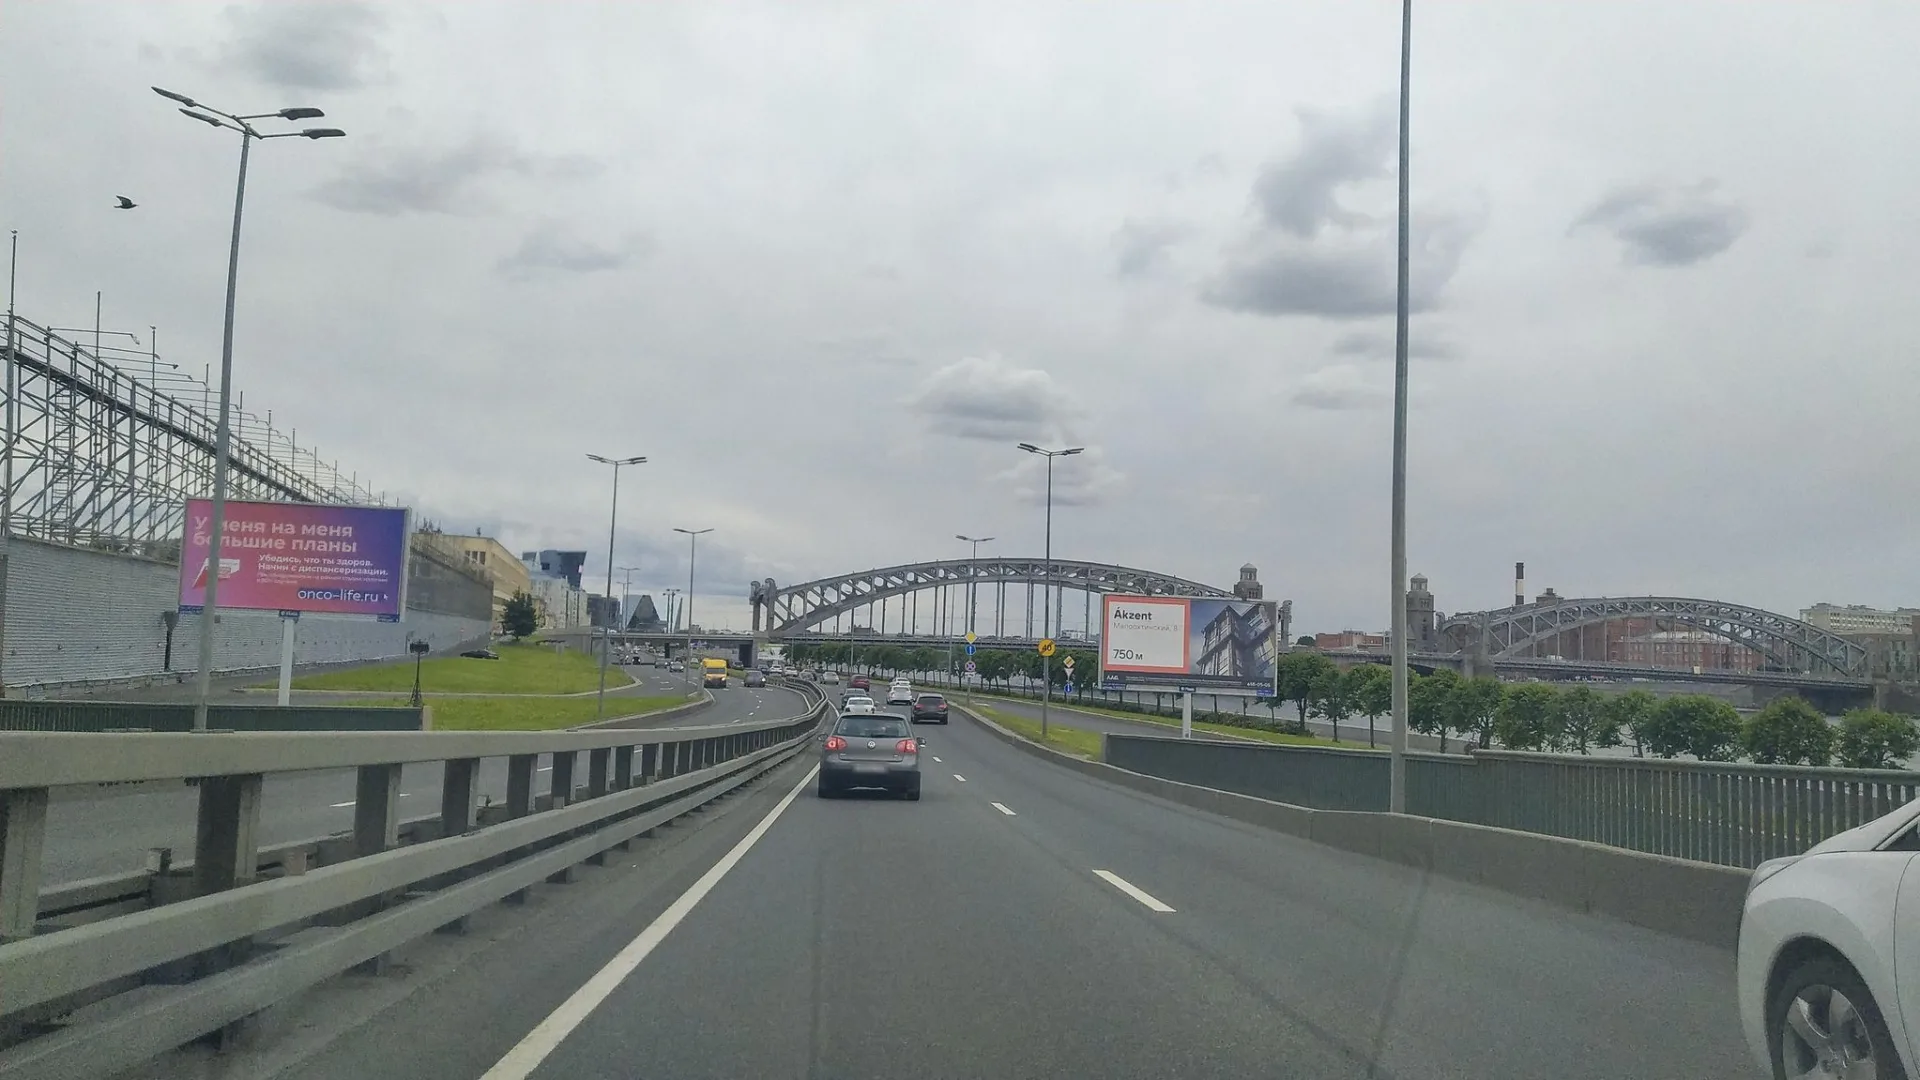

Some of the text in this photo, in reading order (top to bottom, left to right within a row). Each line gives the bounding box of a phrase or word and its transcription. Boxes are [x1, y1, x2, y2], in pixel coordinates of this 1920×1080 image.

[194, 516, 353, 537] У еня на меня
[291, 539, 357, 553] планы
[259, 554, 301, 563] Убедись,
[336, 559, 373, 567] здоров.
[258, 562, 289, 571] Начни
[298, 566, 388, 576] диспансеризации.
[297, 589, 379, 602] onco-life.ru
[1113, 606, 1153, 620] Ákzent
[1042, 644, 1052, 652] 40
[1113, 649, 1134, 660] 750
